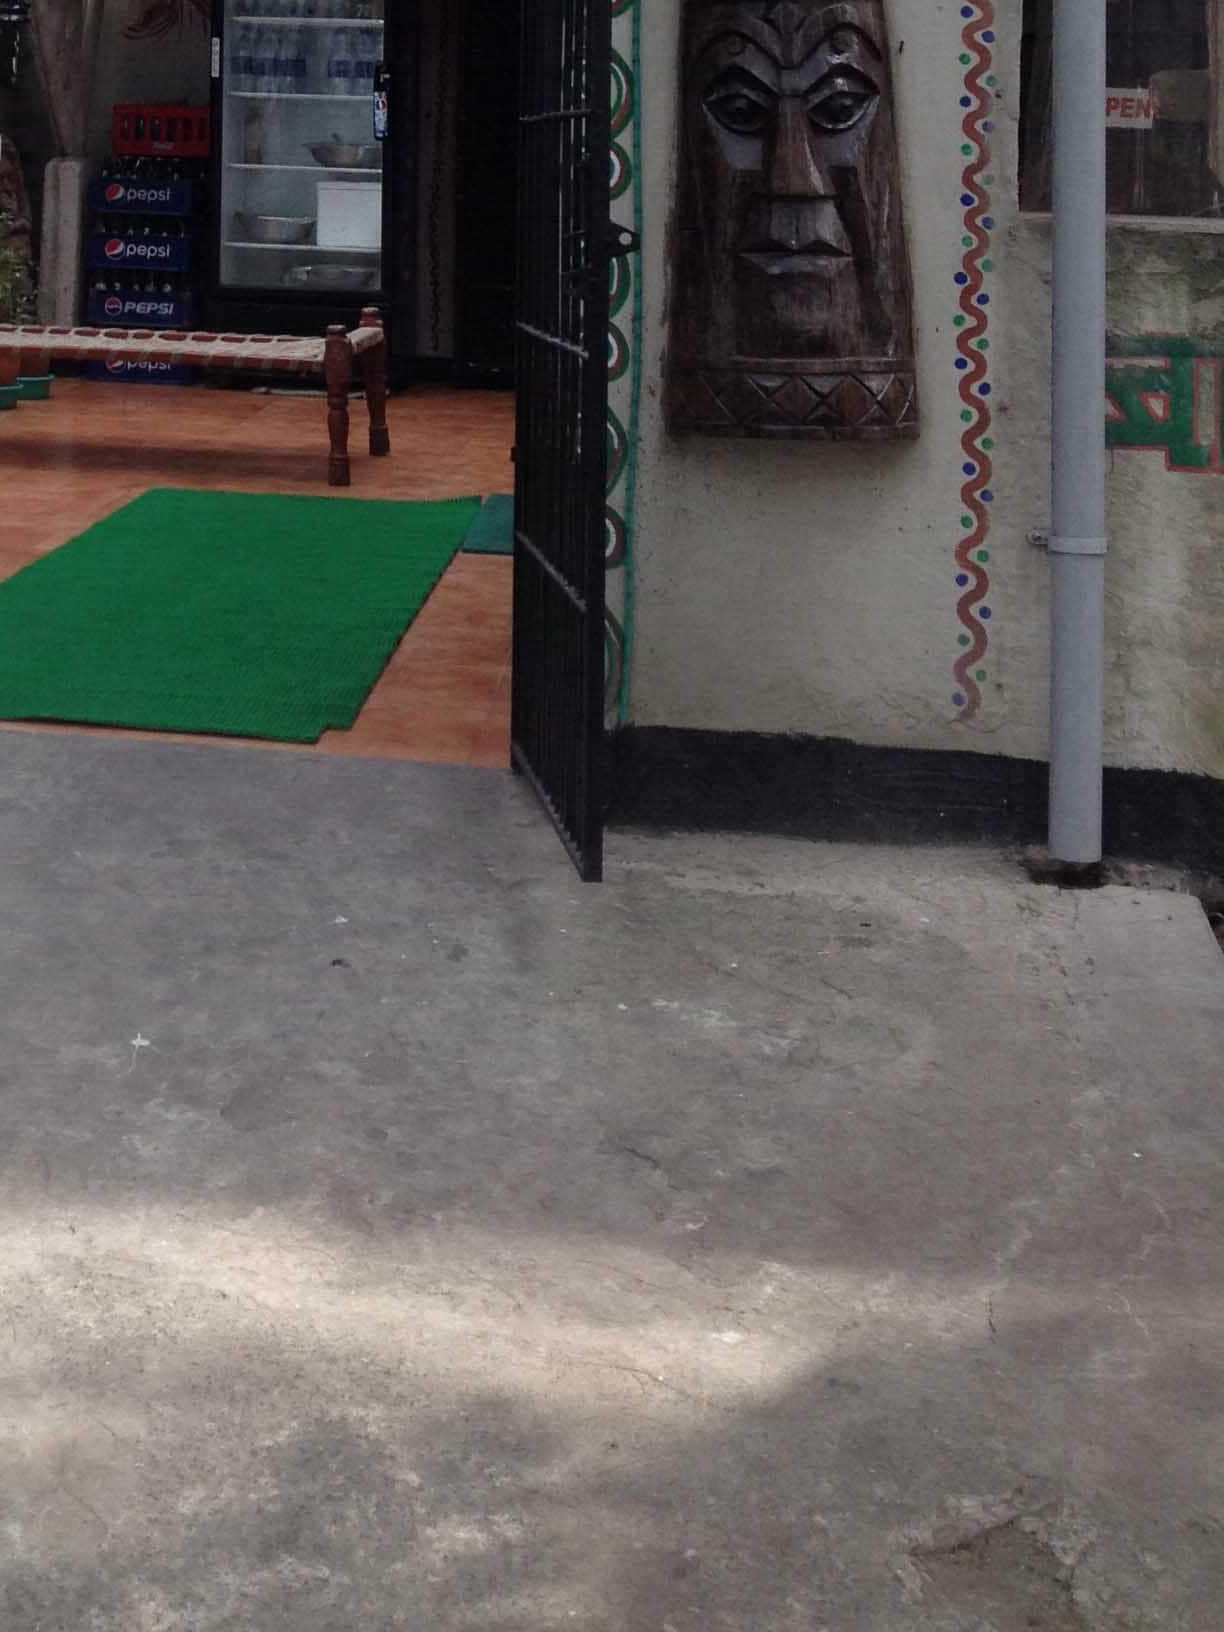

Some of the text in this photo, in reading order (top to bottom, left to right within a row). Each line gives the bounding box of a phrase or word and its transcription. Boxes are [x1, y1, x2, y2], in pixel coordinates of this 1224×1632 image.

[1106, 96, 1152, 118] PEN
[127, 187, 170, 204] pepsi
[126, 243, 170, 260] pepsi
[124, 301, 174, 315] PEPSI
